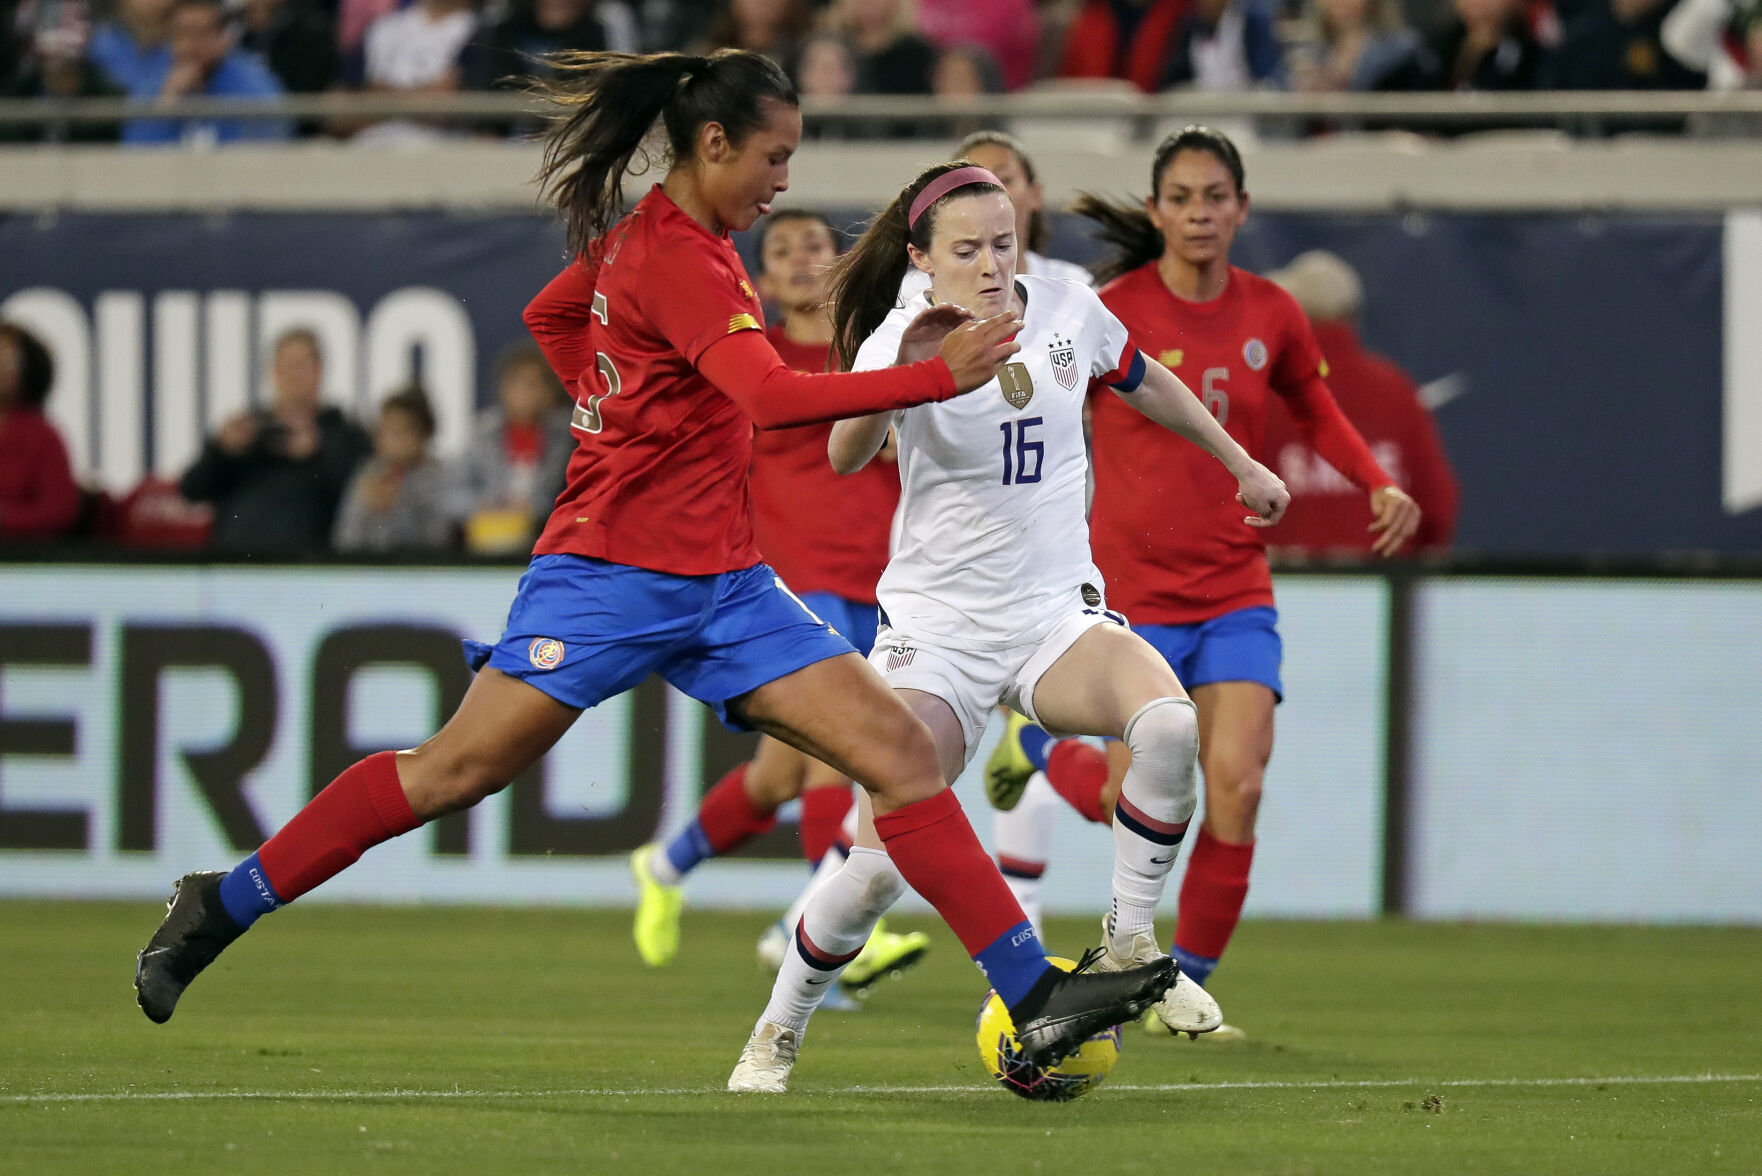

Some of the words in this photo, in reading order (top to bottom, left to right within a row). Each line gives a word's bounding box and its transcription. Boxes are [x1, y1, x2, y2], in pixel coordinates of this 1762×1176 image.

[1052, 351, 1073, 367] USA
[1011, 390, 1027, 399] FIFA
[1201, 367, 1229, 427] 6
[1000, 416, 1044, 485] 16
